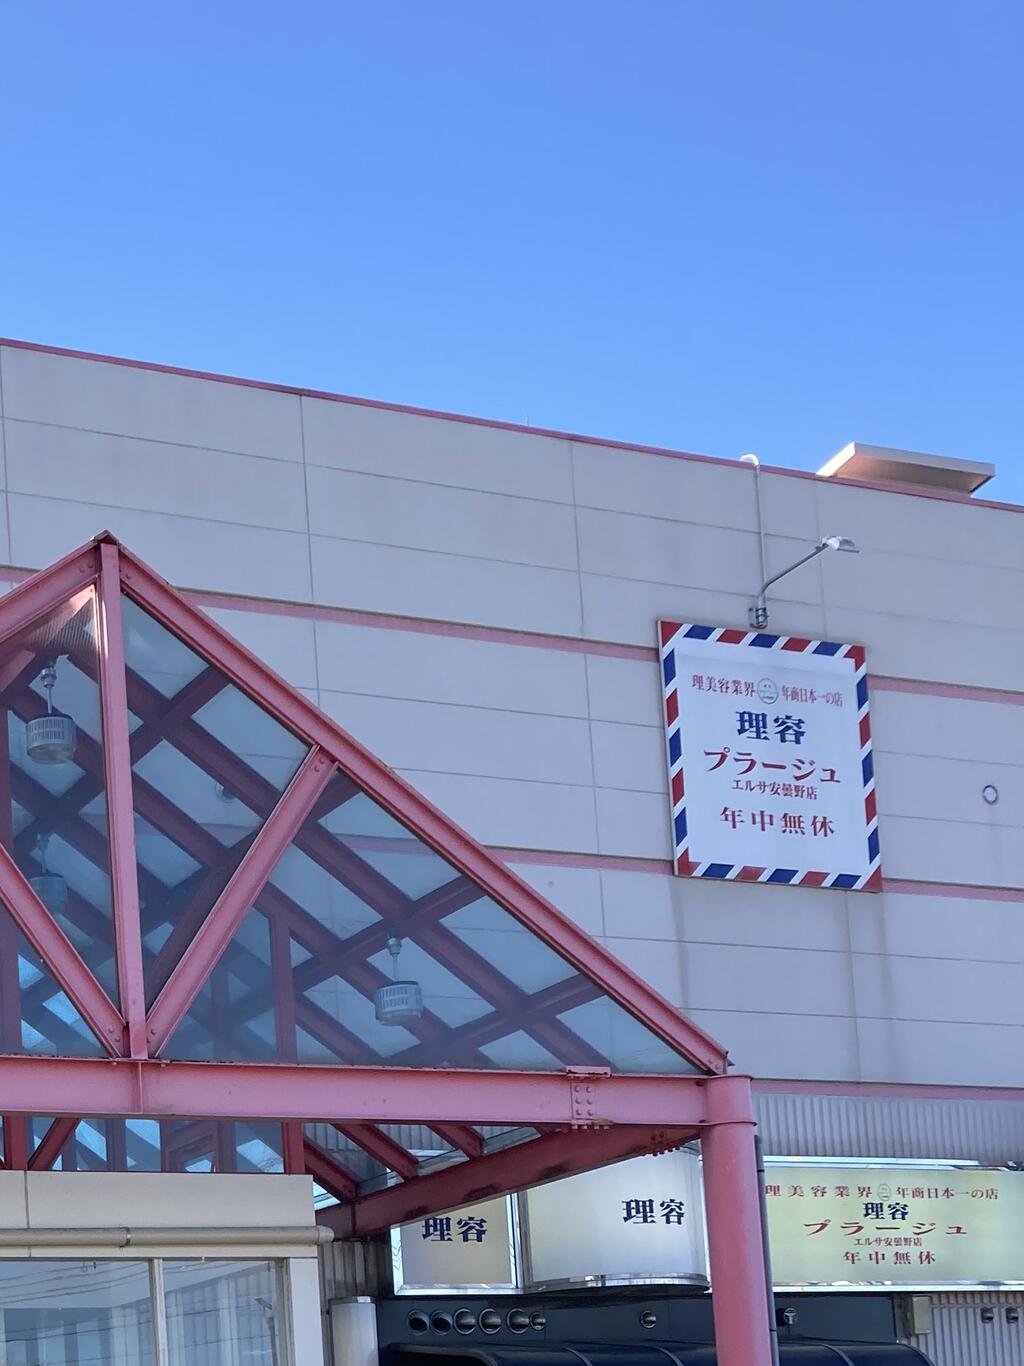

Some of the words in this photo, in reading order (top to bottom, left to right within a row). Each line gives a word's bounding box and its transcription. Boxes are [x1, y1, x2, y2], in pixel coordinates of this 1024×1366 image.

[691, 674, 756, 698] 理美容業界
[781, 685, 844, 708] 年商日本一の店
[736, 710, 806, 745] 理容
[703, 747, 841, 784] プラージュ
[731, 779, 818, 801] エルサ安曇野店
[719, 806, 835, 838] 年中無休
[765, 1184, 873, 1199] 理美容業界
[896, 1186, 999, 1201] 年商日本一の店
[621, 1198, 686, 1226] 理容
[863, 1201, 909, 1221] 理容
[421, 1216, 488, 1243] 理容
[803, 1218, 968, 1236] プラージュ
[854, 1237, 923, 1247] エルサ安曇野店
[843, 1251, 936, 1265] 年中無休
